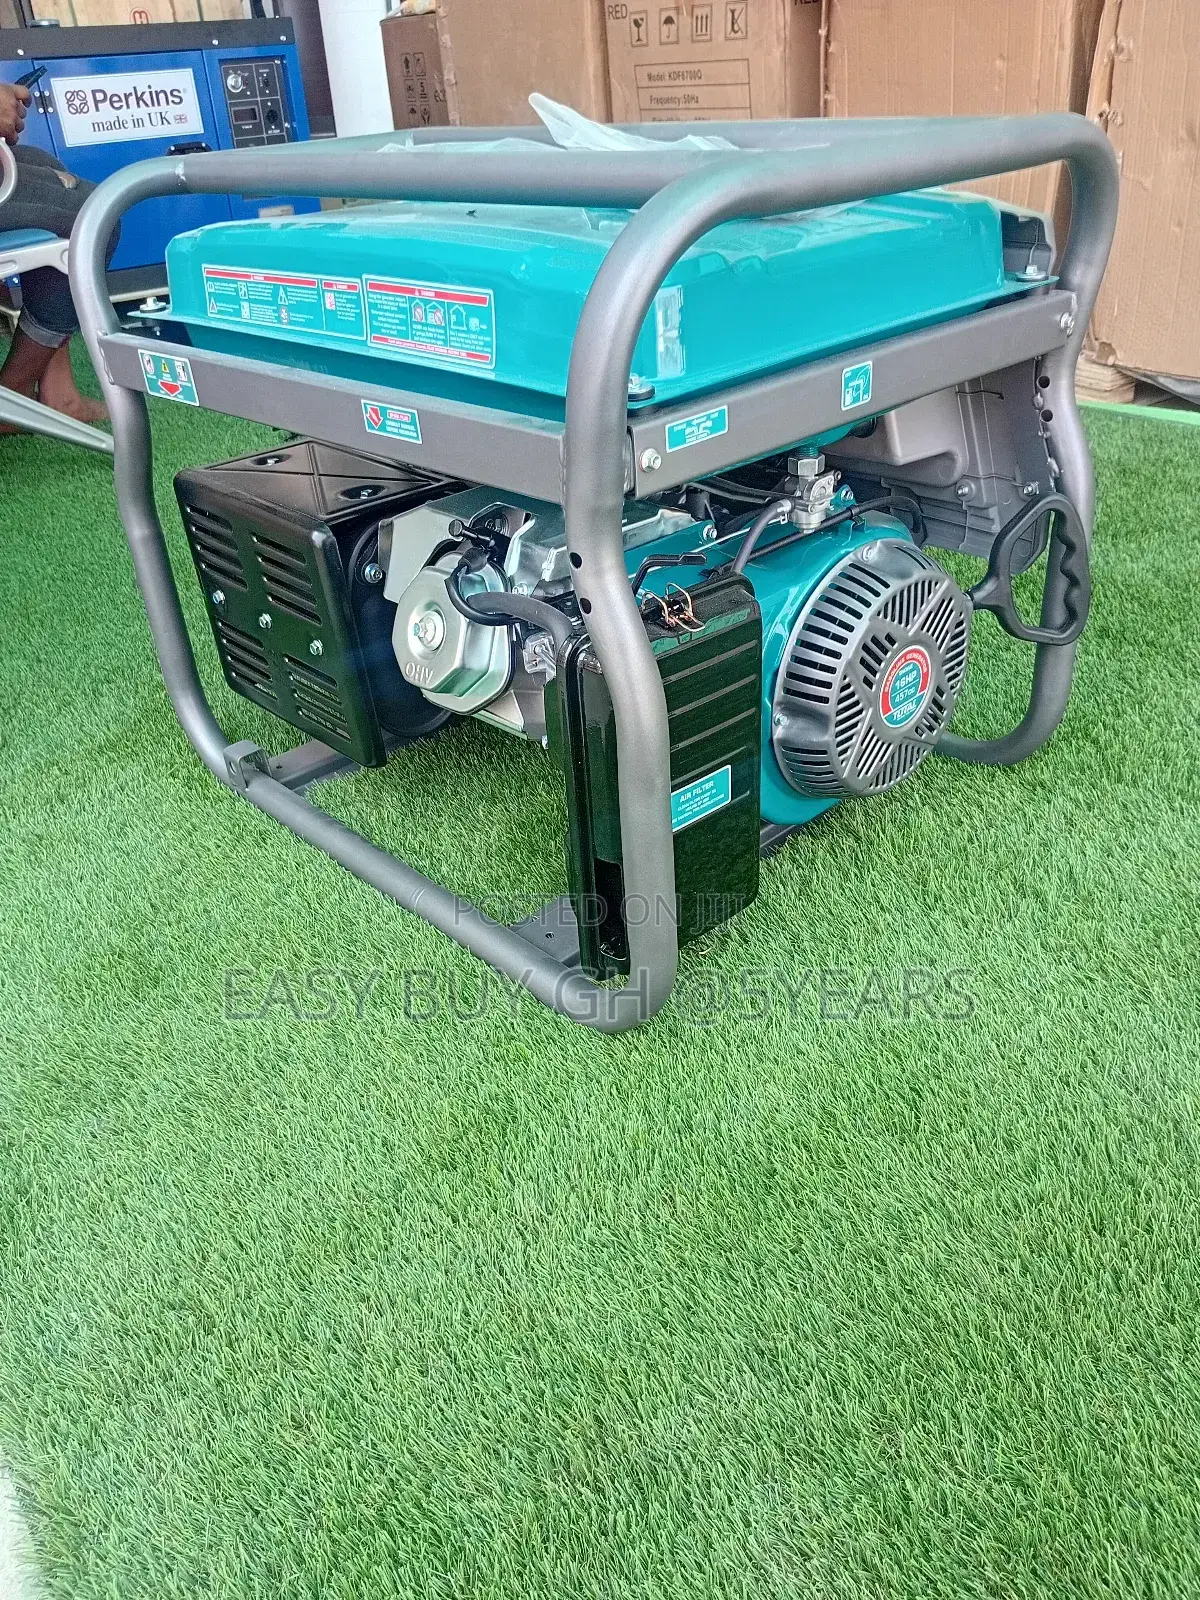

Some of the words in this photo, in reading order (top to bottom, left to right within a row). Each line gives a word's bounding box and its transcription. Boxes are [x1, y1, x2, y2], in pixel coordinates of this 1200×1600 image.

[607, 4, 628, 20] RED
[91, 85, 184, 113] Perkins
[92, 115, 129, 132] made
[132, 115, 145, 129] in
[147, 111, 171, 127] UK
[405, 662, 434, 684] OHV
[895, 669, 917, 689] 16HP
[895, 686, 916, 703] 457cc
[893, 699, 917, 720] TOTAL
[681, 792, 692, 802] AIR
[693, 781, 714, 796] FILTER
